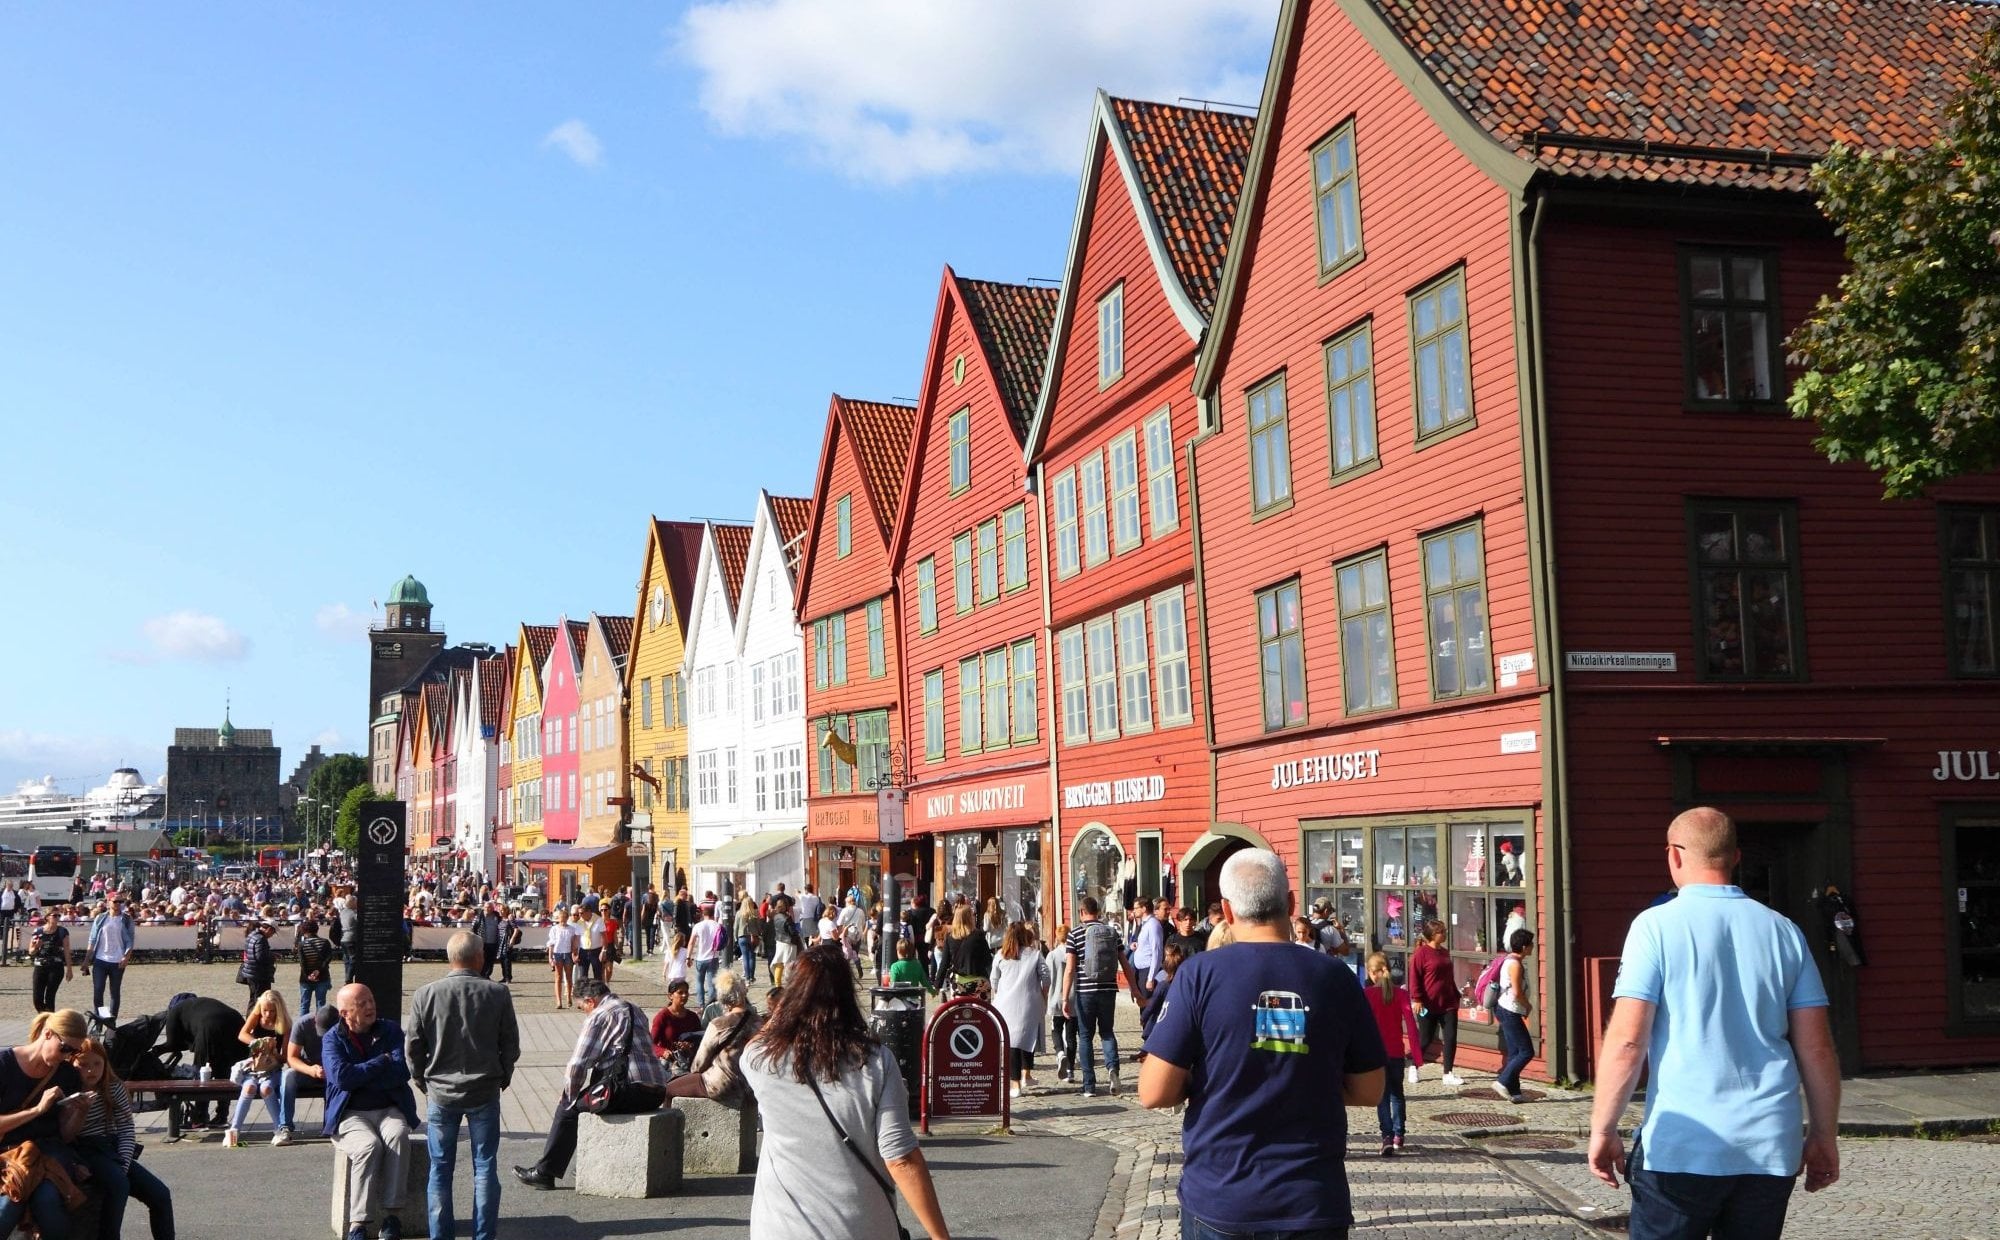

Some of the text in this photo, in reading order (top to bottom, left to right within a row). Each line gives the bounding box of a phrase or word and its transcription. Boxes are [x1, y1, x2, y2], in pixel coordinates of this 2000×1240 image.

[1571, 655, 1672, 669] Nikolaikirkeallmenningen
[1271, 749, 1381, 790] JULEHUSET
[1932, 751, 2000, 781] JUL
[927, 783, 1025, 819] KNUT SKURTVEIT
[1064, 774, 1165, 809] BRYGGEN HUSFLID
